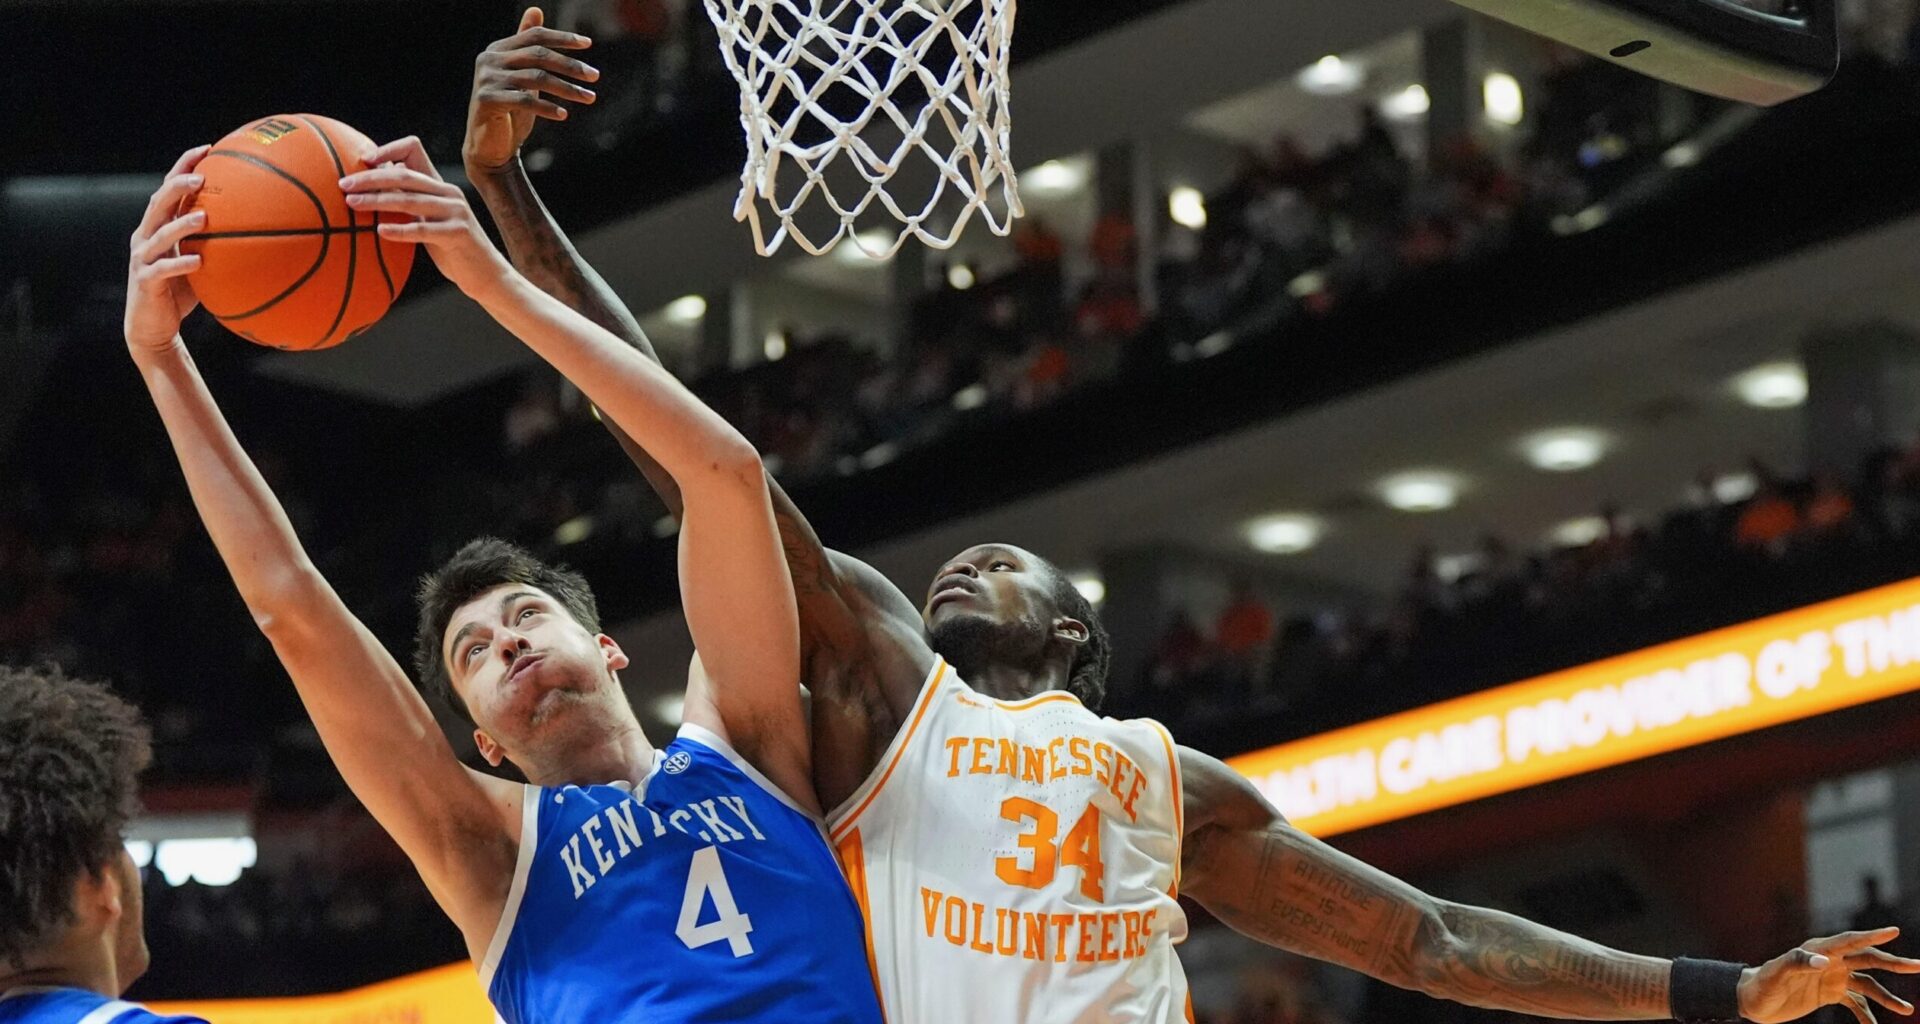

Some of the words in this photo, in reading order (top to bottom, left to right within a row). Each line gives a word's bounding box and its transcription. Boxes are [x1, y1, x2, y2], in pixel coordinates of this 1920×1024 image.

[665, 753, 689, 772] SEC
[1249, 748, 1376, 820] ALTH
[1379, 715, 1501, 794] CARE
[1506, 652, 1752, 763] PROVIDER
[1756, 630, 1832, 698] OF
[946, 737, 1146, 824] TENNESSEE
[559, 796, 766, 899] KENTCKY
[995, 796, 1104, 904] 34
[675, 845, 754, 958] 4
[921, 887, 1157, 963] VOLUNTEERS
[1318, 898, 1338, 915] IS
